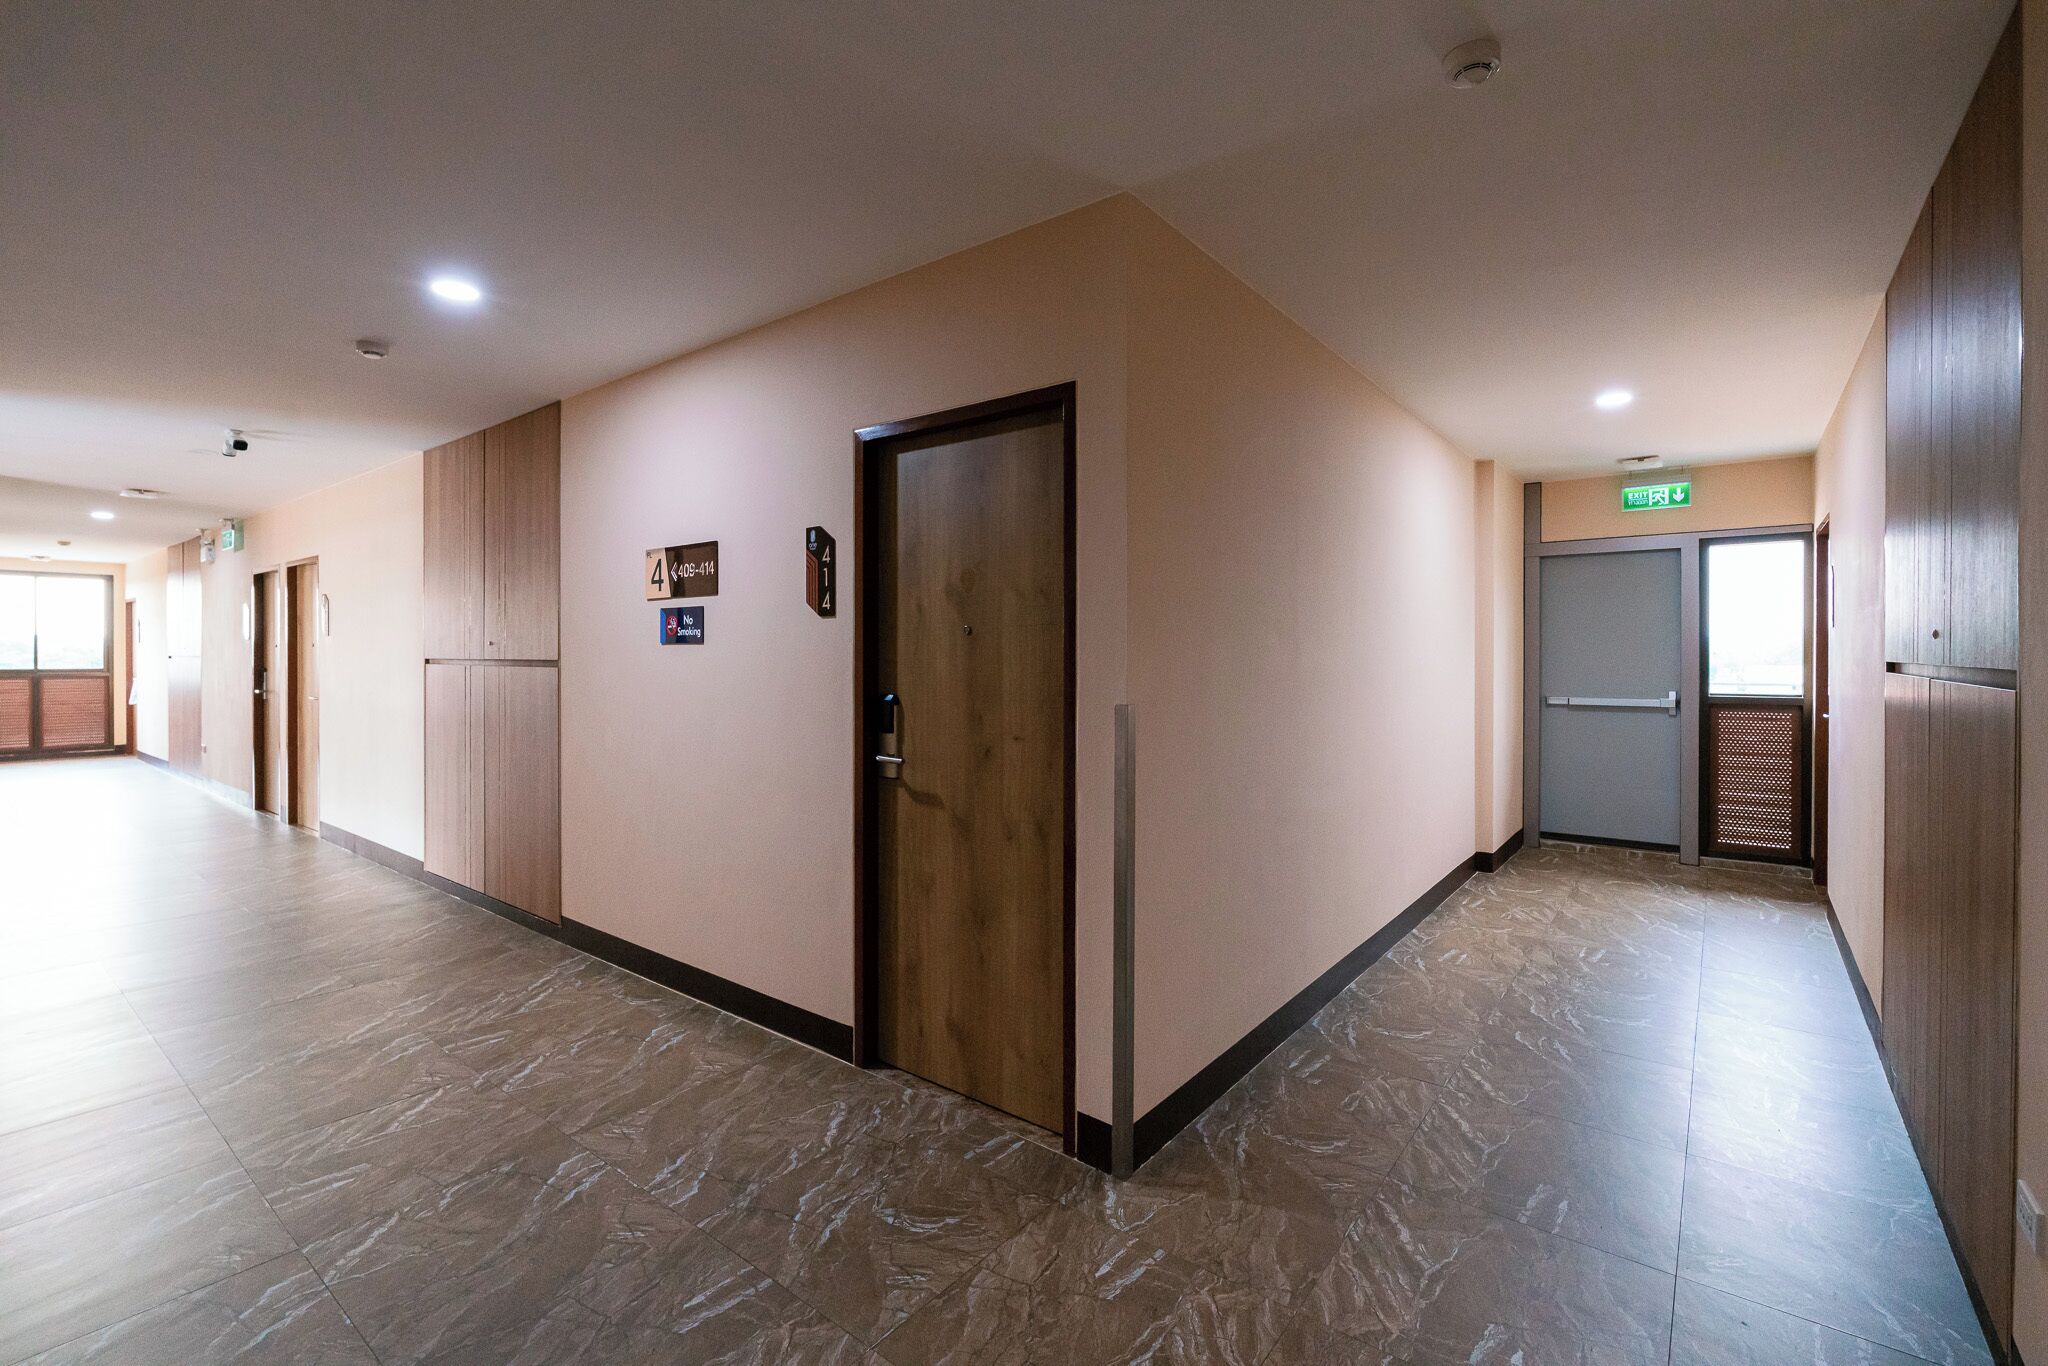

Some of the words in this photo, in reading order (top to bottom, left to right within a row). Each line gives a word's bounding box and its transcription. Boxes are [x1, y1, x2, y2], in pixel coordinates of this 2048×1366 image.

[651, 558, 664, 591] 4
[678, 560, 714, 578] 409-414
[822, 544, 831, 610] 414
[683, 614, 694, 625] No
[677, 626, 701, 638] Smoking
